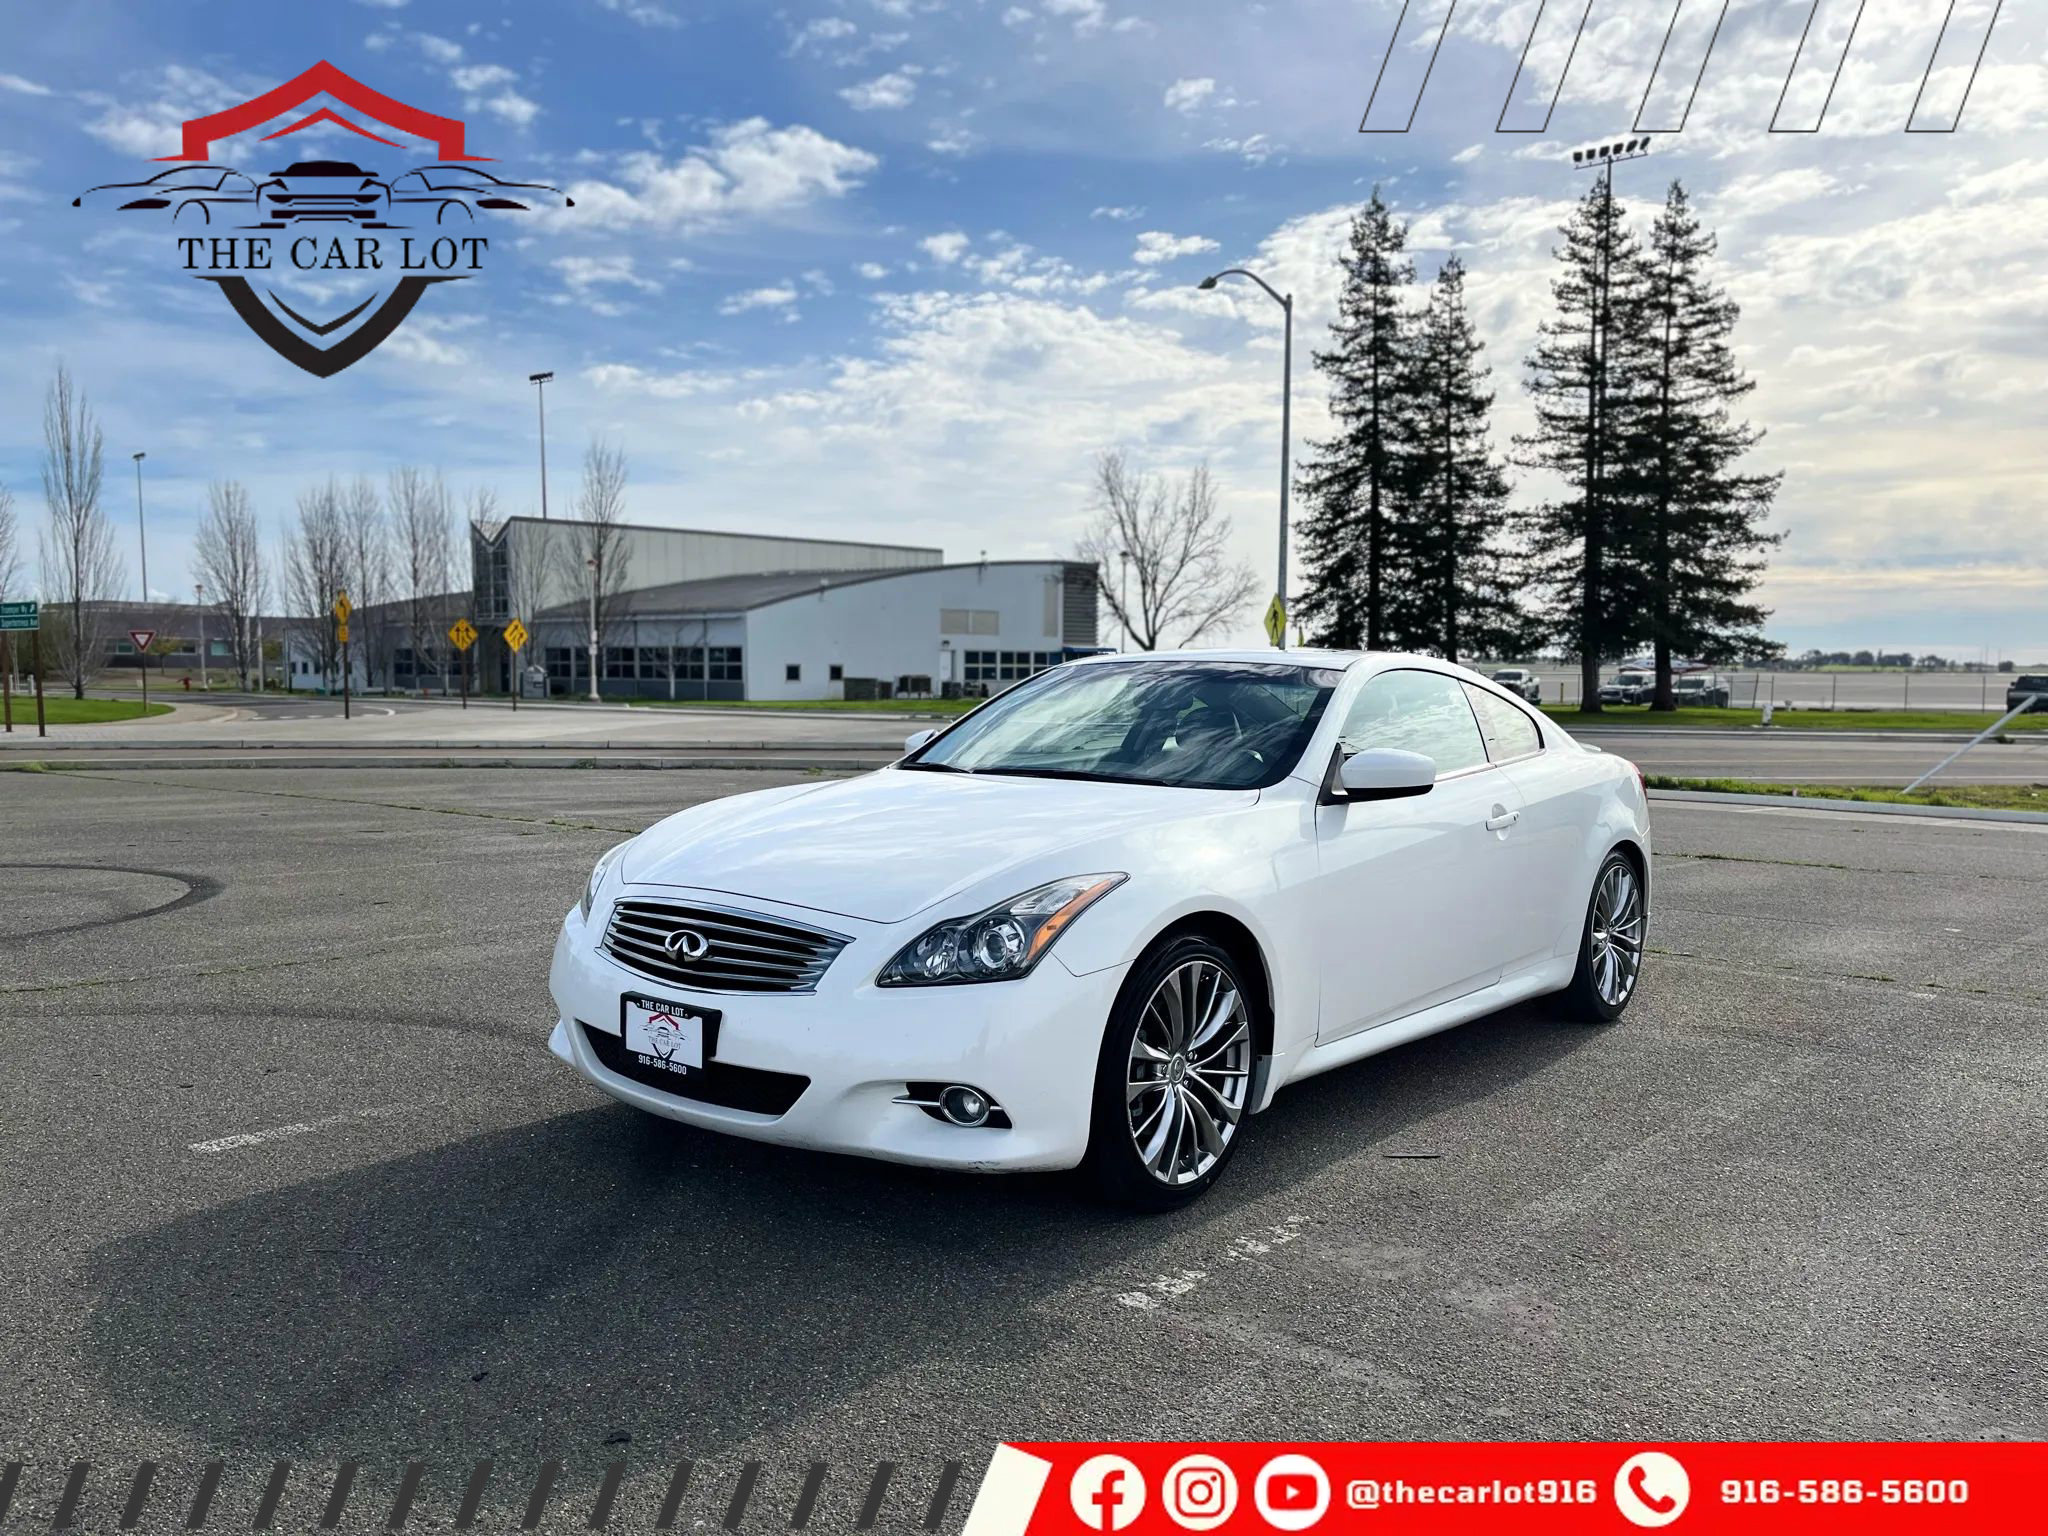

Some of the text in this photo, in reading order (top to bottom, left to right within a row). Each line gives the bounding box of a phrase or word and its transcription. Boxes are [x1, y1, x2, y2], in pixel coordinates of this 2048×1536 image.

[641, 999, 684, 1017] THE CAR LOT
[638, 1054, 687, 1075] 916-586-5600
